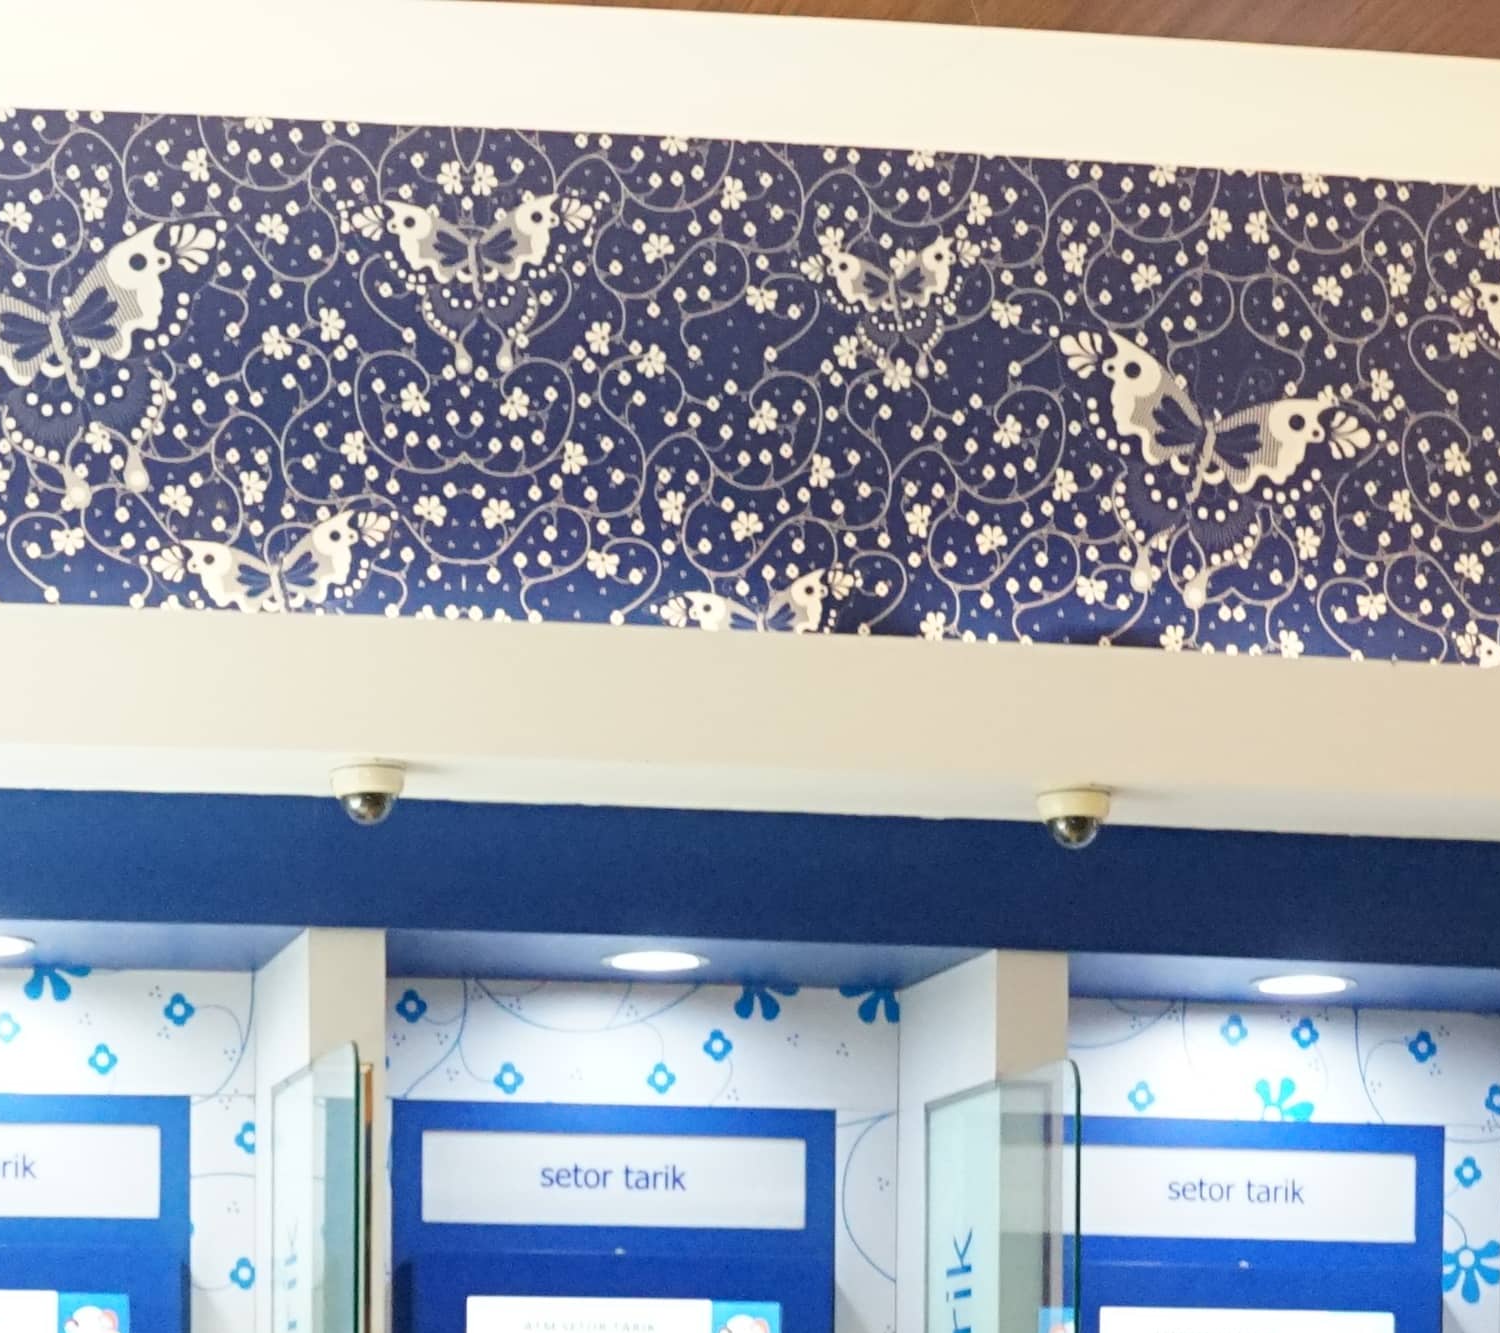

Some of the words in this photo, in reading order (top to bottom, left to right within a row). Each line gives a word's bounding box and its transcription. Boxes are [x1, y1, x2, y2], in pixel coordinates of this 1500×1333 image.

[540, 1164, 612, 1190] setor
[624, 1165, 688, 1192] tarik
[1168, 1178, 1233, 1203] setor
[1247, 1180, 1304, 1206] tarik
